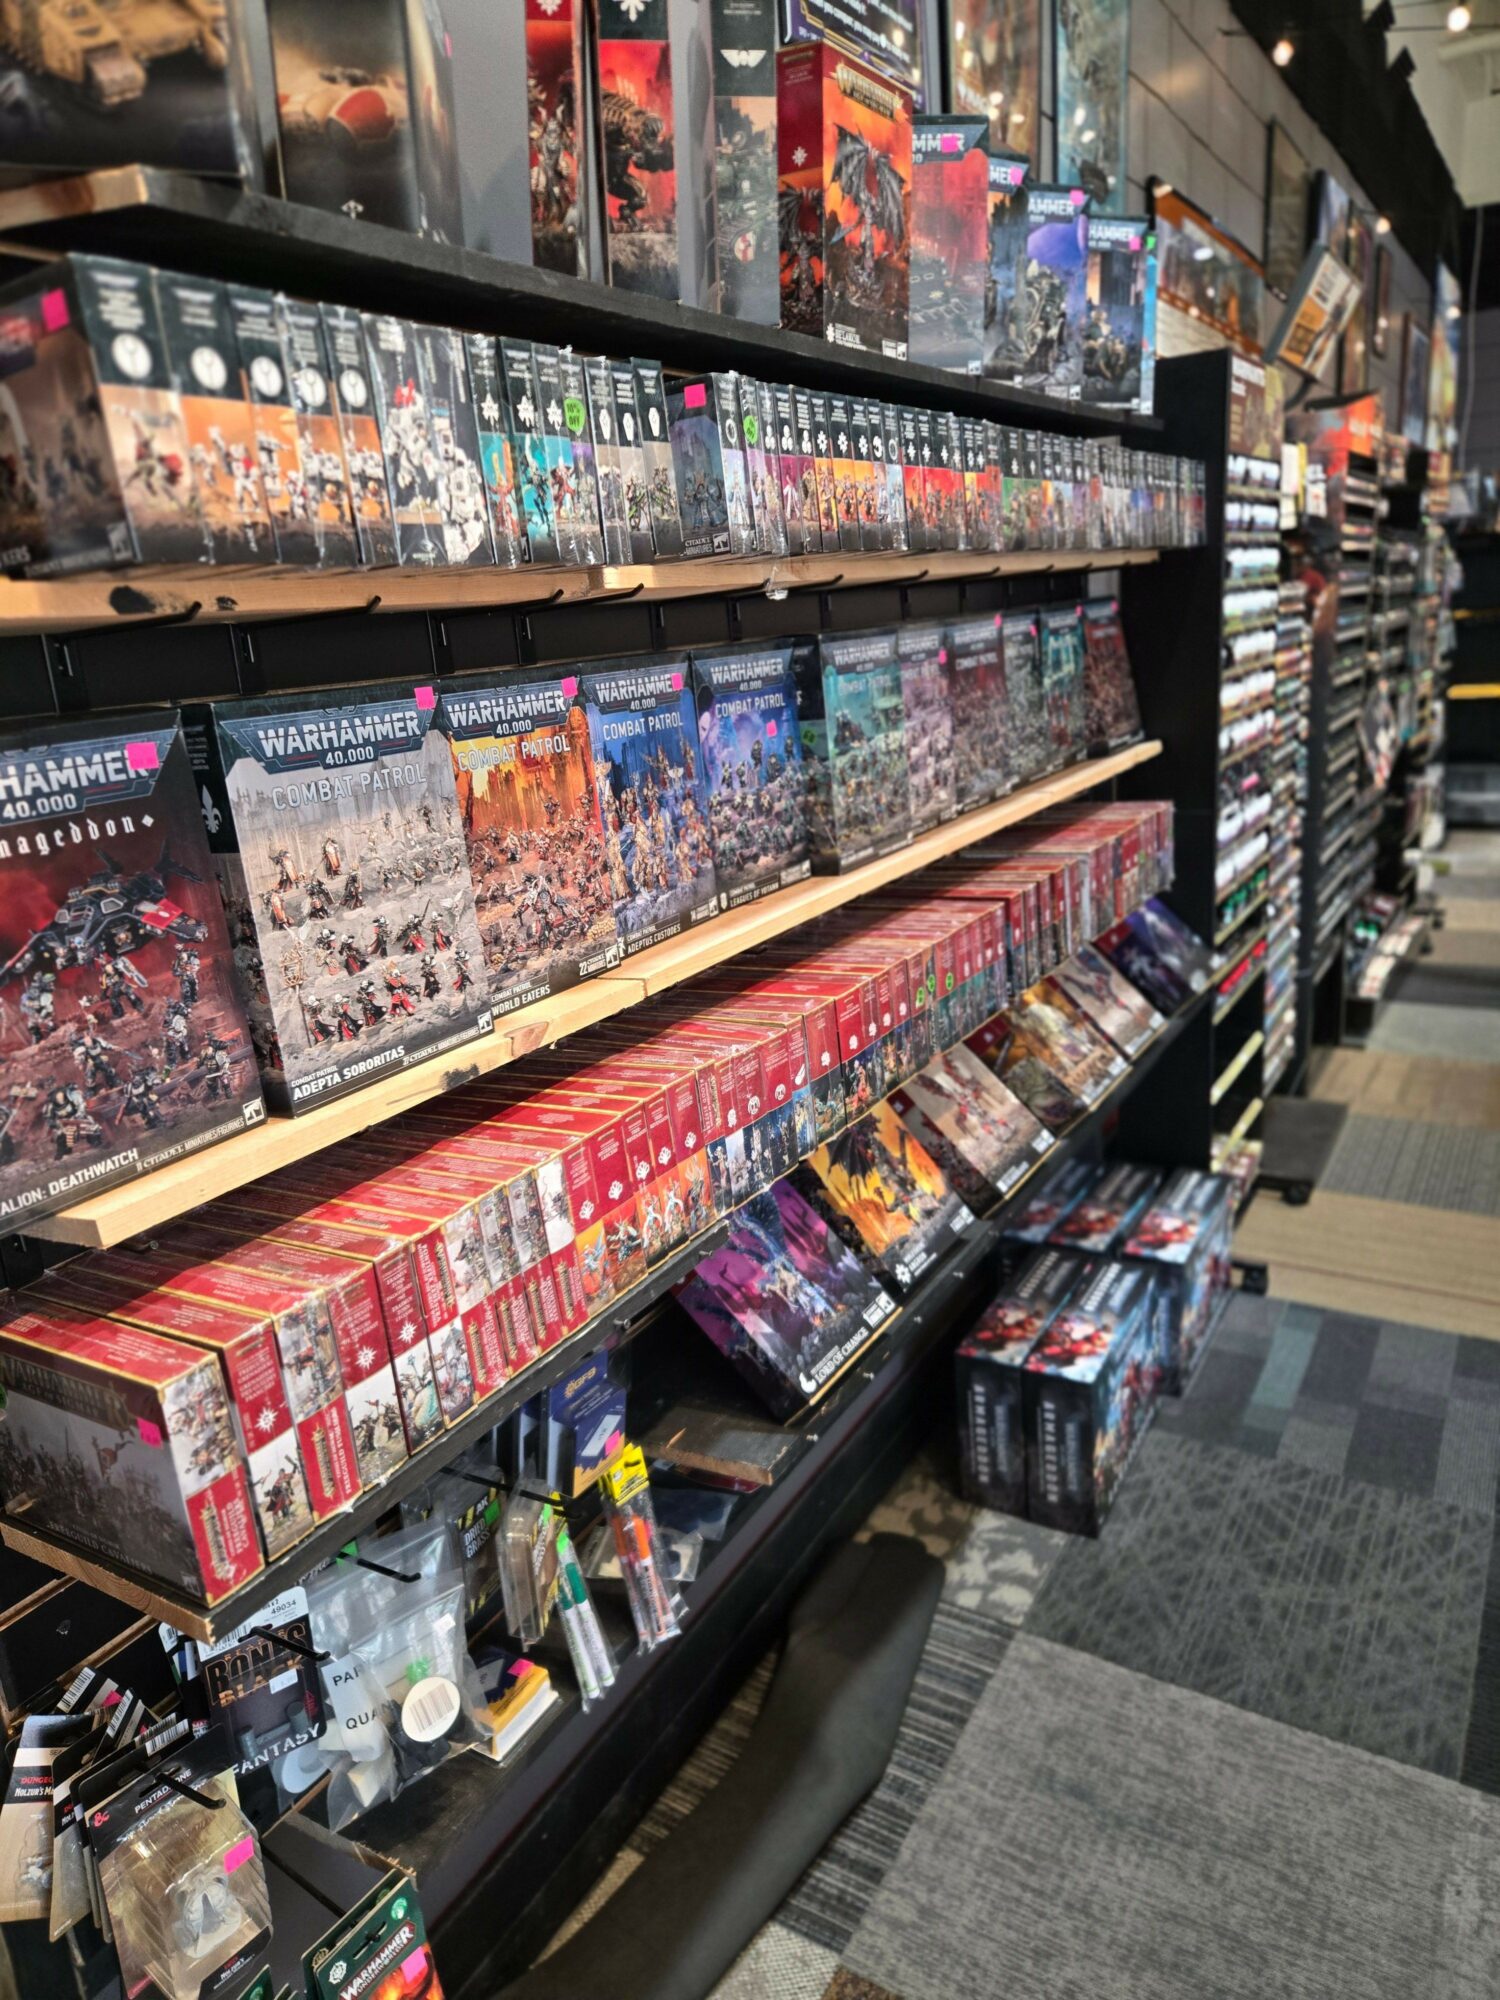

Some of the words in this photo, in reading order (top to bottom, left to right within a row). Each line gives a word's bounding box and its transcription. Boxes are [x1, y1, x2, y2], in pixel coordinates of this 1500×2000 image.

[595, 673, 675, 703] WARHAMME
[710, 658, 785, 685] WARHAMMER
[447, 691, 567, 729] WARHAMMER
[715, 698, 753, 719] COMBAT
[754, 692, 787, 711] PATROL
[257, 710, 421, 758] WARHAMMER
[495, 718, 533, 736] 40,000
[602, 719, 646, 742] COMBAT
[647, 711, 684, 733] PATROL
[325, 745, 375, 767] 40,000
[457, 742, 517, 773] COMBAT
[520, 734, 572, 760] PATROL
[271, 776, 354, 811] COMBAT
[358, 763, 427, 794] PATROL
[627, 933, 653, 955] ADEPTUS
[653, 922, 681, 943] CUSTODES
[491, 989, 513, 1003] COMBAT
[512, 981, 532, 995] PATROL
[492, 995, 520, 1017] WORLD
[521, 984, 551, 1003] EATERS
[291, 1073, 317, 1088] COMBAT
[316, 1064, 338, 1079] PATROL
[293, 1074, 342, 1100] ADEPTA
[343, 1045, 405, 1080] SORORITAS
[48, 1148, 140, 1196] DEATHWATCH
[814, 1360, 836, 1385] LORD
[841, 1326, 870, 1357] CHANGE
[464, 1518, 486, 1546] DRIED
[466, 1528, 491, 1559] GRASS
[271, 1599, 297, 1615] 49034
[205, 1623, 306, 1706] BONS
[232, 1722, 322, 1776] FANTASY
[135, 1769, 192, 1815] PENTADNE
[340, 1925, 415, 2000] WARHAMMER
